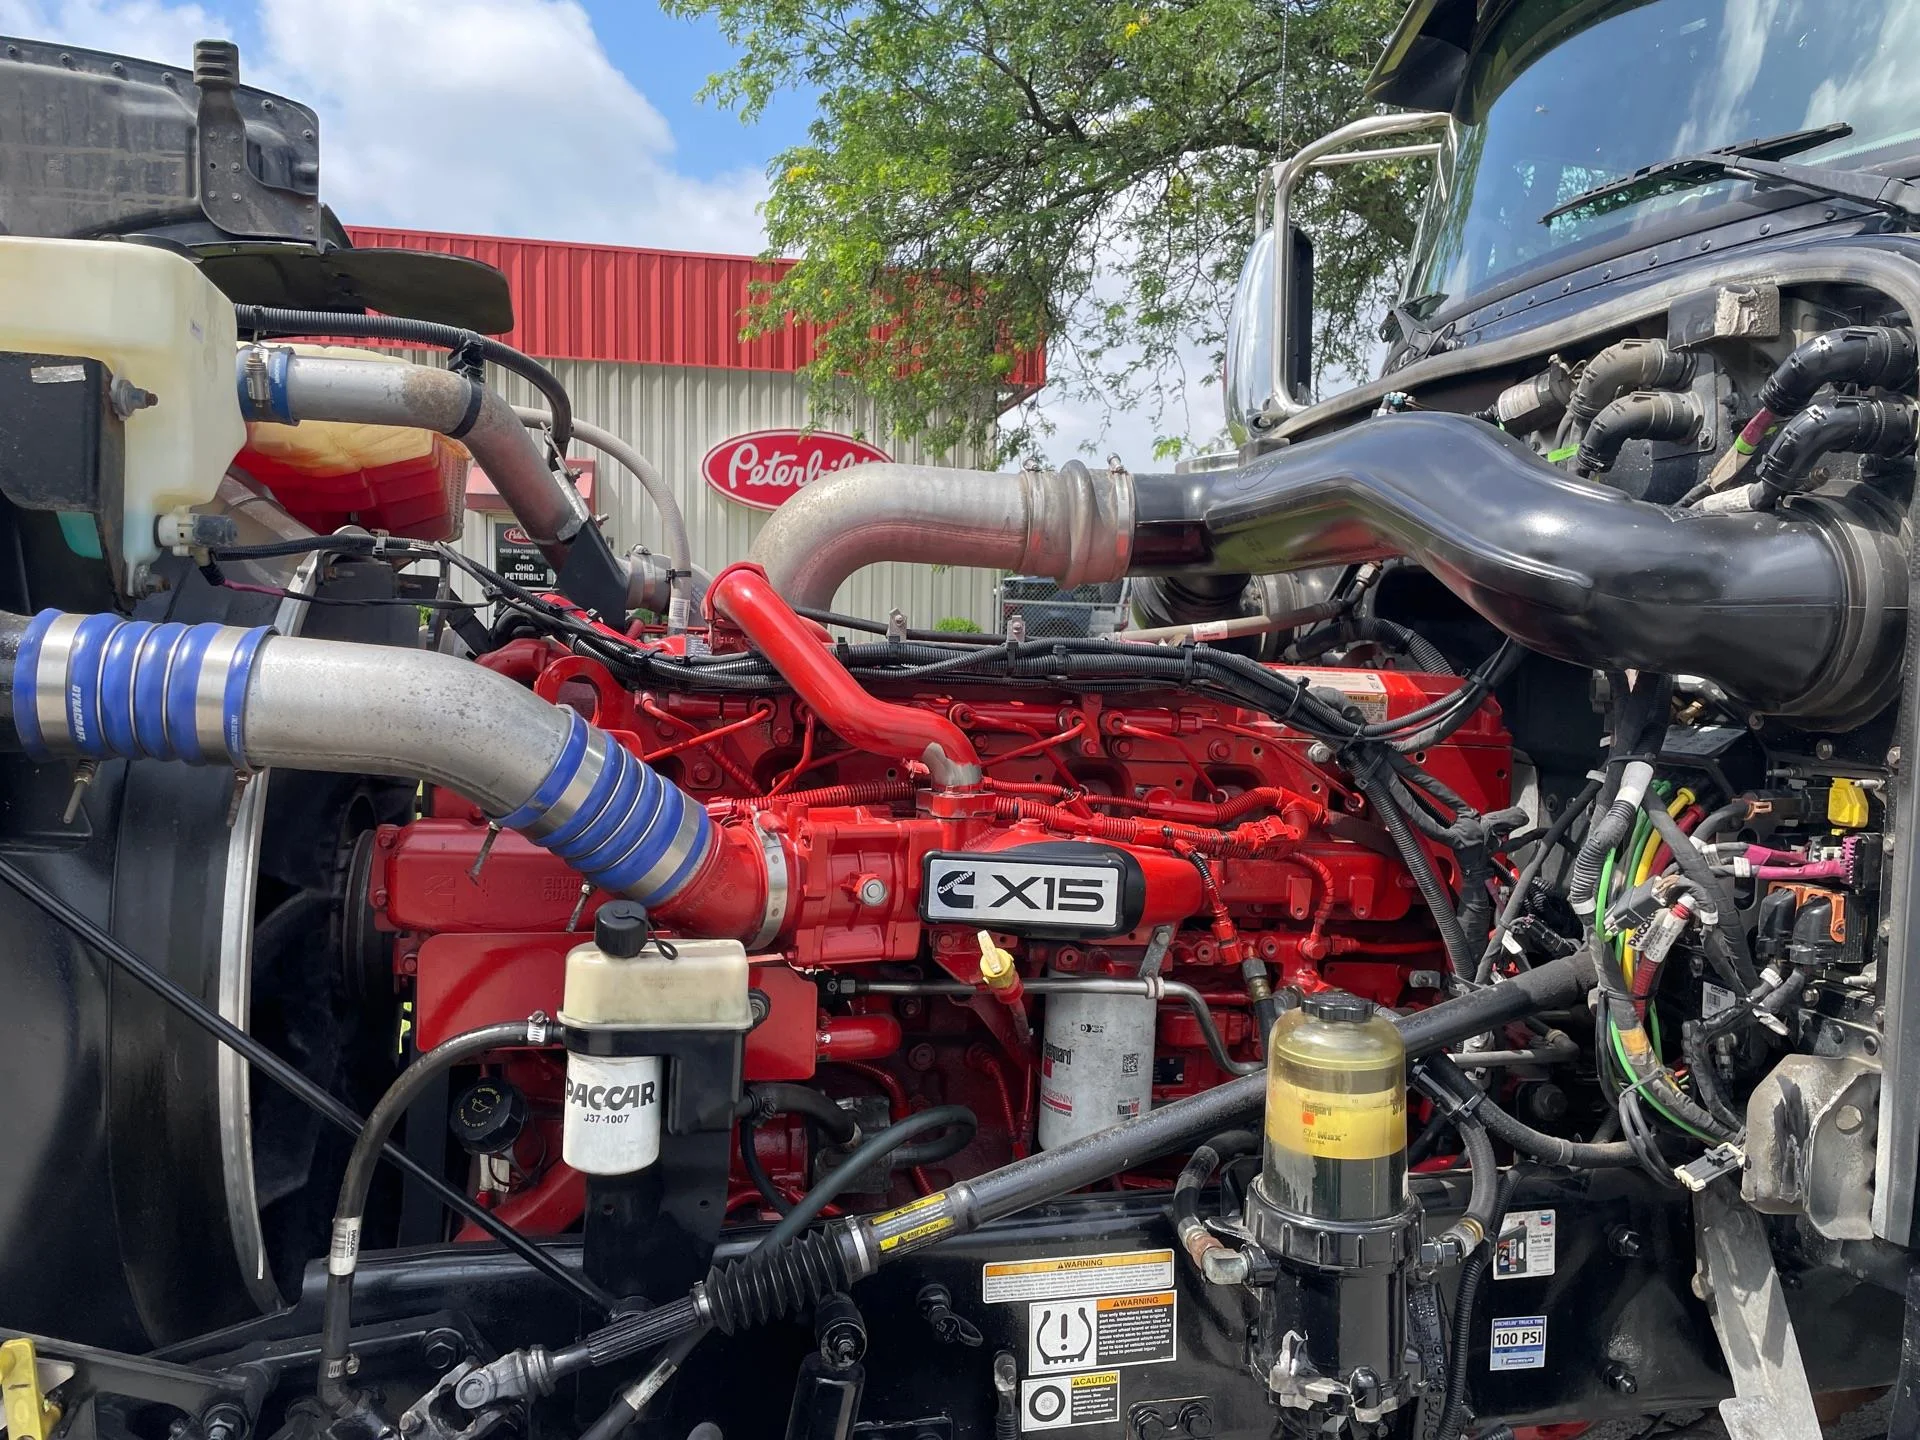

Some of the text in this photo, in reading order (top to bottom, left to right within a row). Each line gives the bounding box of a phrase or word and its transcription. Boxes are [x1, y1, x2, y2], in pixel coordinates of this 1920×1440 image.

[505, 573, 545, 581] PETERBILT
[988, 874, 1104, 912] X15
[566, 1076, 655, 1110] PACCAR
[584, 1114, 629, 1124] J37-1007
[1064, 1259, 1103, 1269] WARNING
[1120, 1297, 1158, 1306] WARNING
[1496, 1331, 1541, 1345] 100 PSI
[1080, 1376, 1117, 1384] CAUTION
